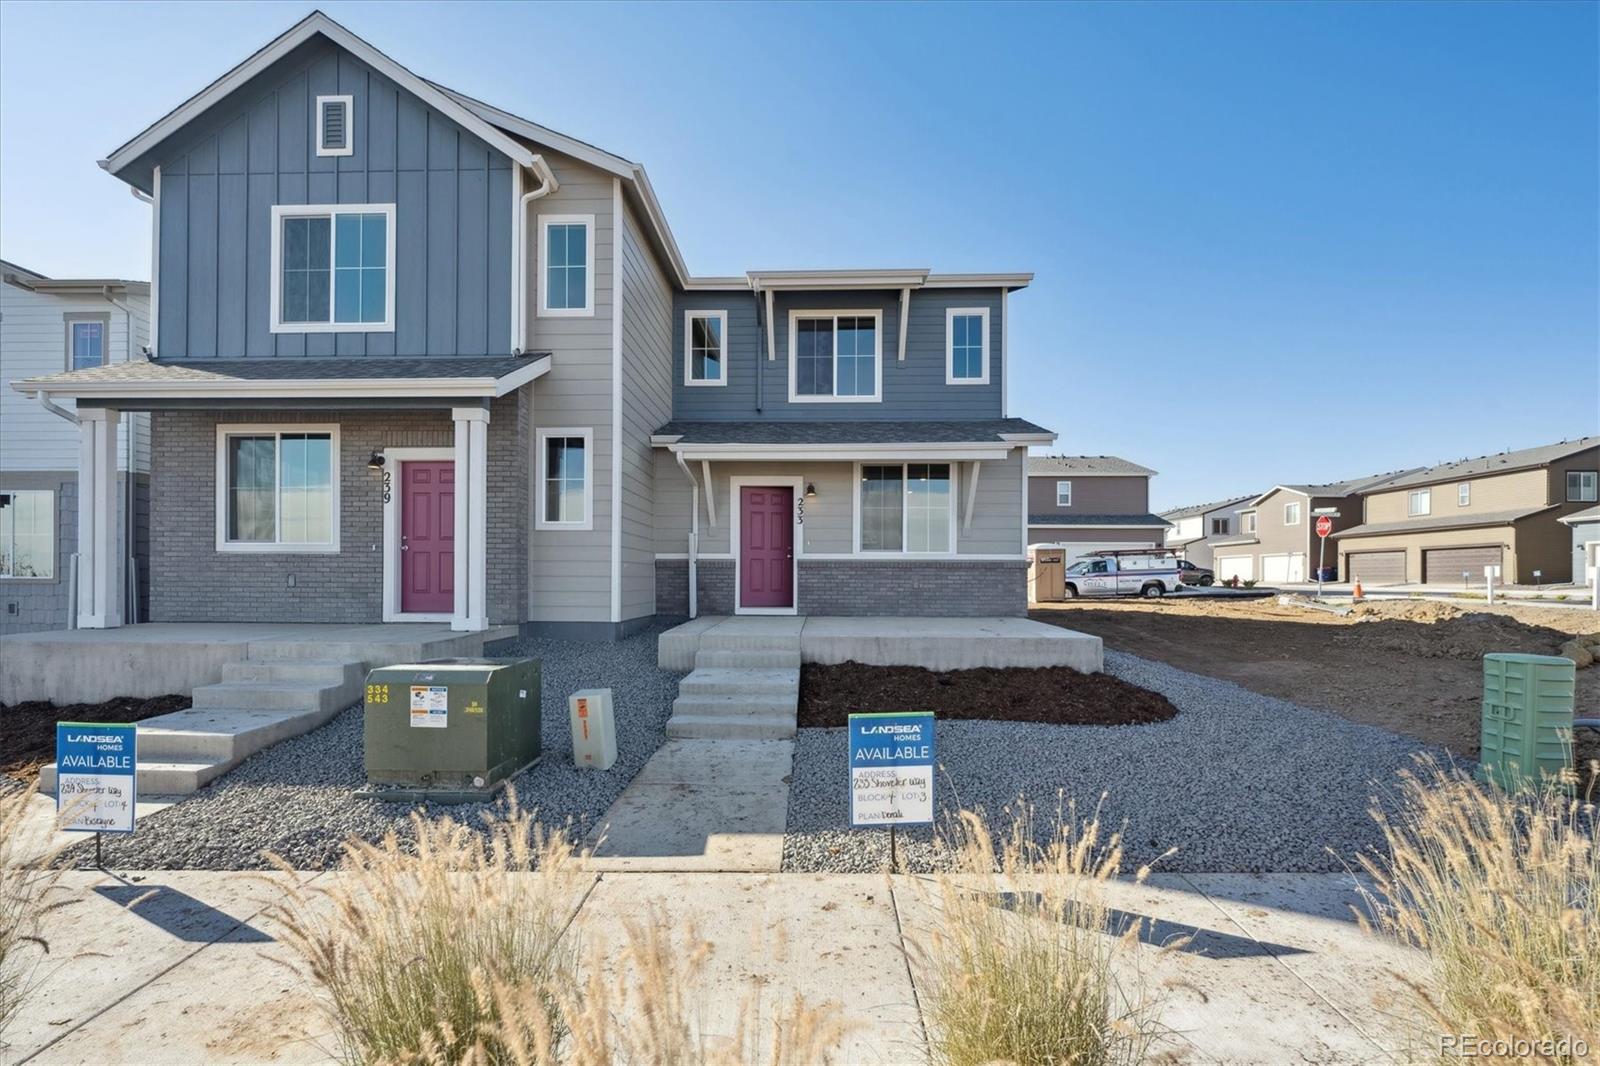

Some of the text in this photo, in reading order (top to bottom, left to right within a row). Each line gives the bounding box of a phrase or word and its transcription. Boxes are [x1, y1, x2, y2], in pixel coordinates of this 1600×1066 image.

[1316, 522, 1330, 531] STOP
[367, 685, 388, 694] 334
[367, 694, 388, 703] 543
[855, 746, 929, 760] AVAILABLE
[61, 755, 131, 769] AVAILABLE
[853, 777, 870, 789] 233
